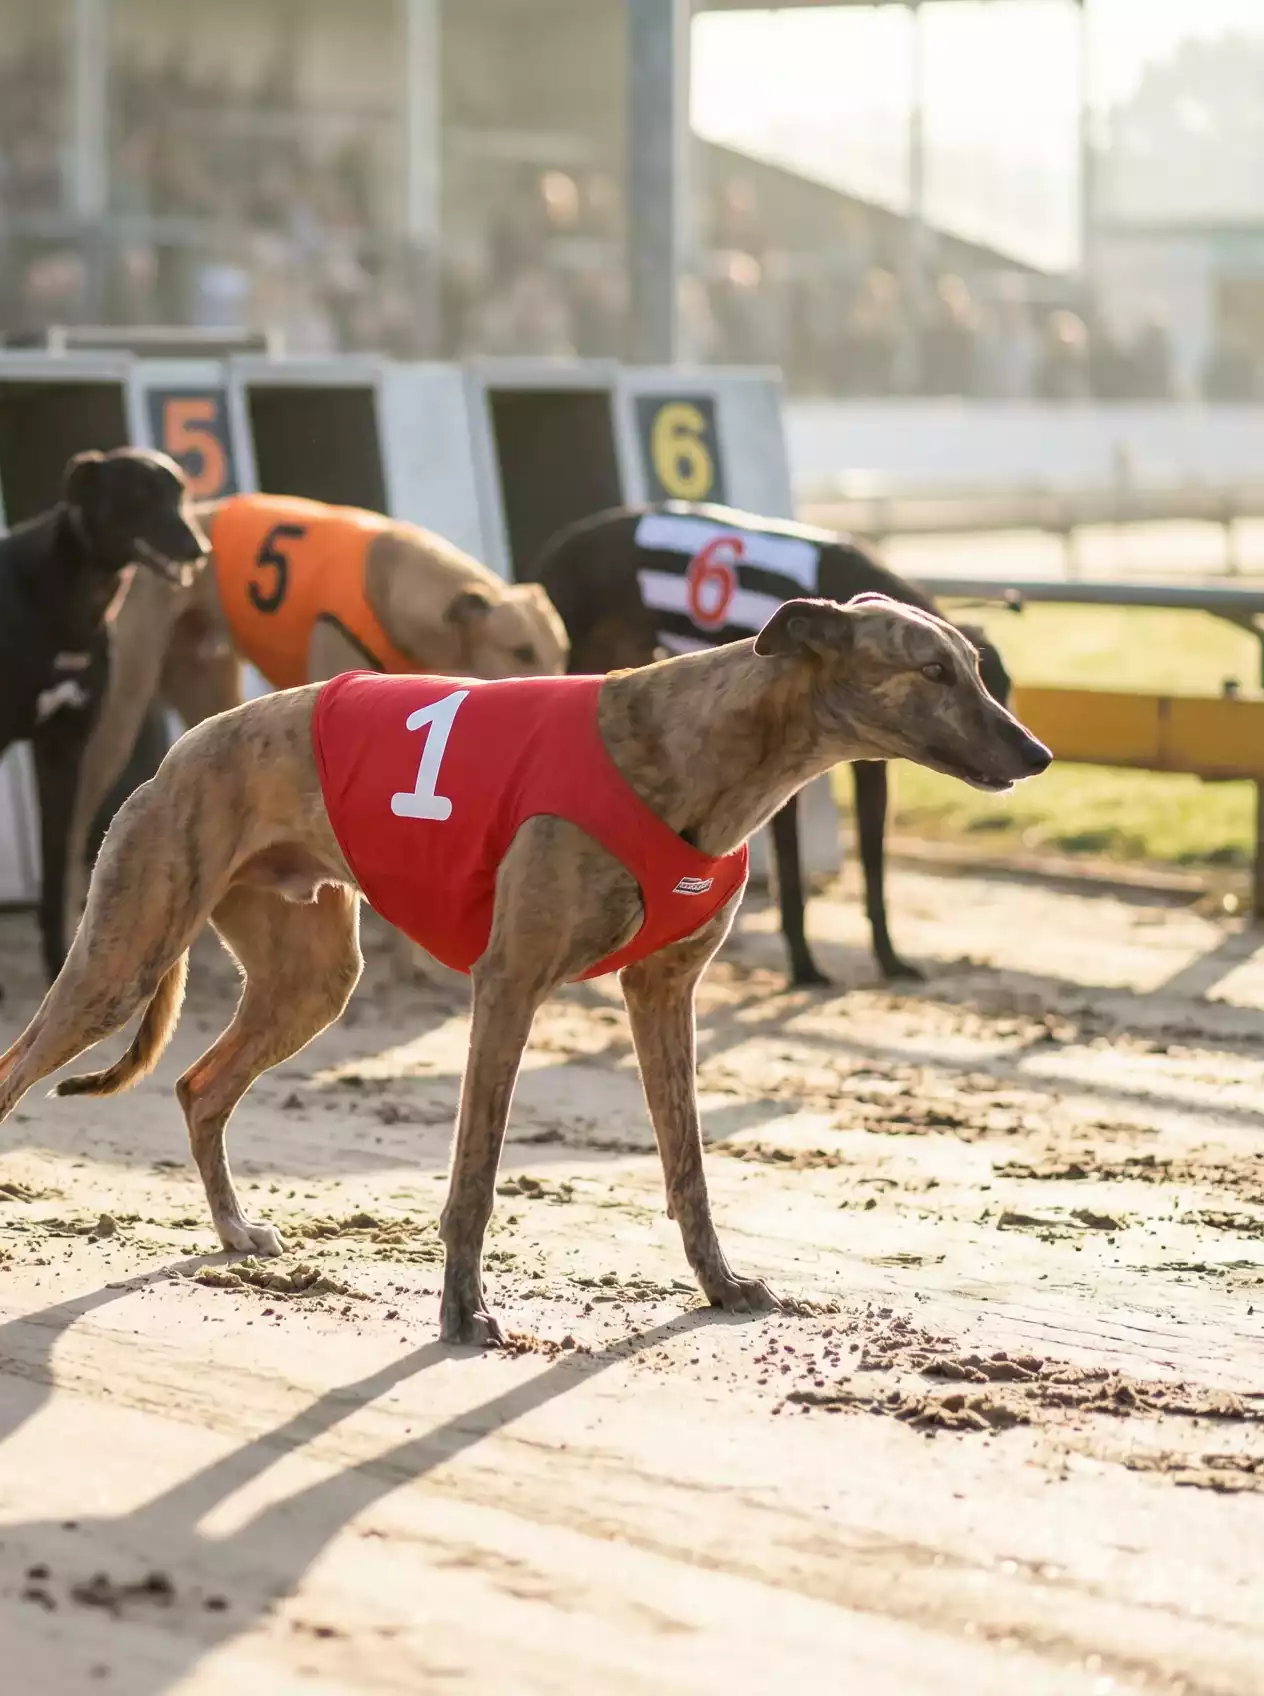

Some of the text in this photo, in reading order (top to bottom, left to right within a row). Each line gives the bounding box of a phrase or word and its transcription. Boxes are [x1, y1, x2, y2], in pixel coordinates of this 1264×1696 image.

[163, 398, 226, 498] 5
[651, 402, 714, 500] 6
[248, 525, 306, 613] 5
[688, 537, 744, 625] 6
[391, 690, 469, 820] 1
